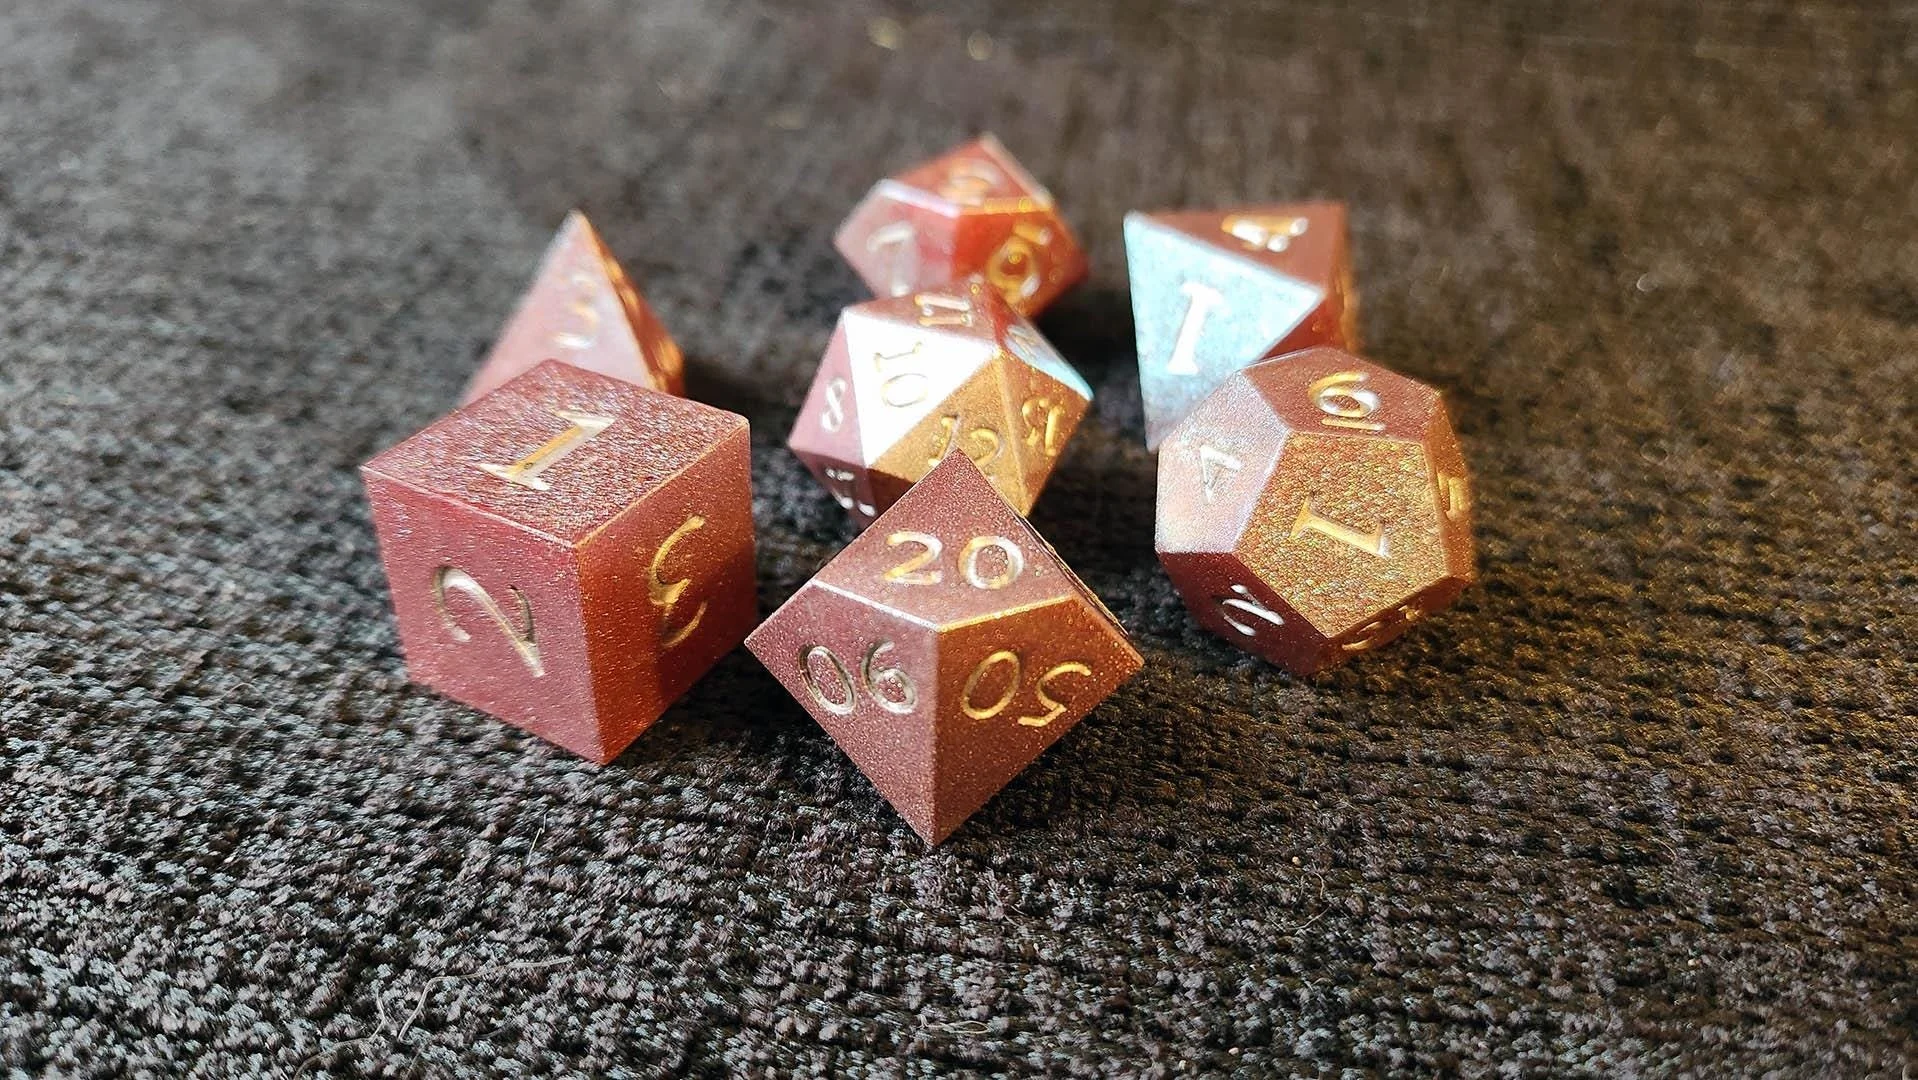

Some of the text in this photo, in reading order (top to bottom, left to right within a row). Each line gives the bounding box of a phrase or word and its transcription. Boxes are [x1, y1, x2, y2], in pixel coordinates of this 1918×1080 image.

[1166, 281, 1231, 376] 1
[820, 376, 848, 434] 8
[873, 340, 930, 408] 10
[1308, 371, 1387, 431] 6
[478, 408, 617, 491] 1
[882, 529, 1025, 591] 20
[1290, 489, 1392, 560] 1
[432, 564, 546, 679] 2
[960, 650, 1093, 728] 50
